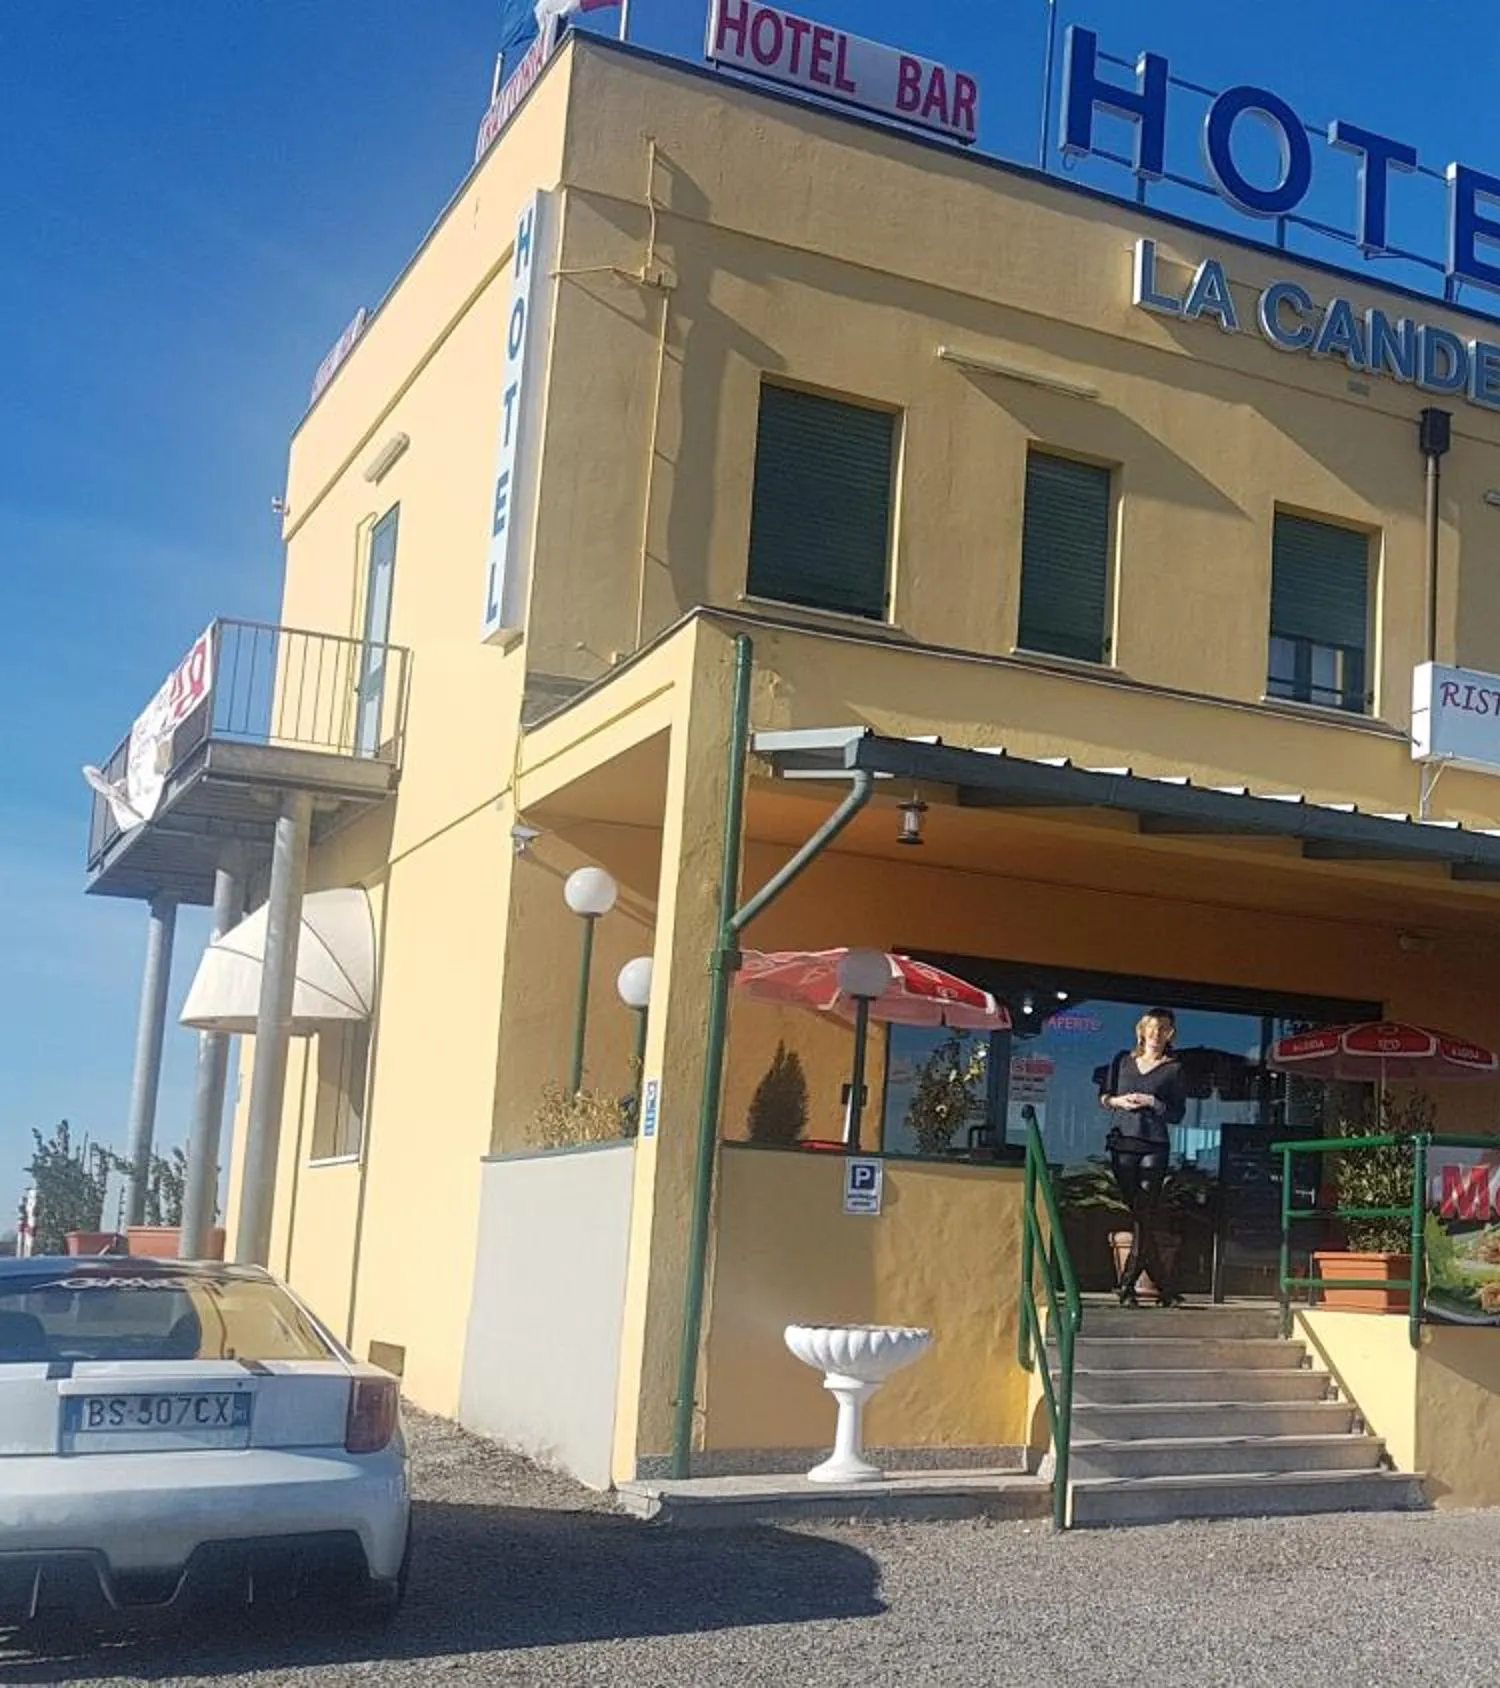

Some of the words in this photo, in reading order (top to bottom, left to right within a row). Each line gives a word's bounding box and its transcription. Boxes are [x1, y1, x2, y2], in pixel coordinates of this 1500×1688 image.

[714, 0, 857, 94] HOTEL
[895, 54, 977, 133] BAR
[1133, 238, 1240, 333] LA
[485, 207, 533, 625] HOTEL
[855, 1167, 871, 1187] P
